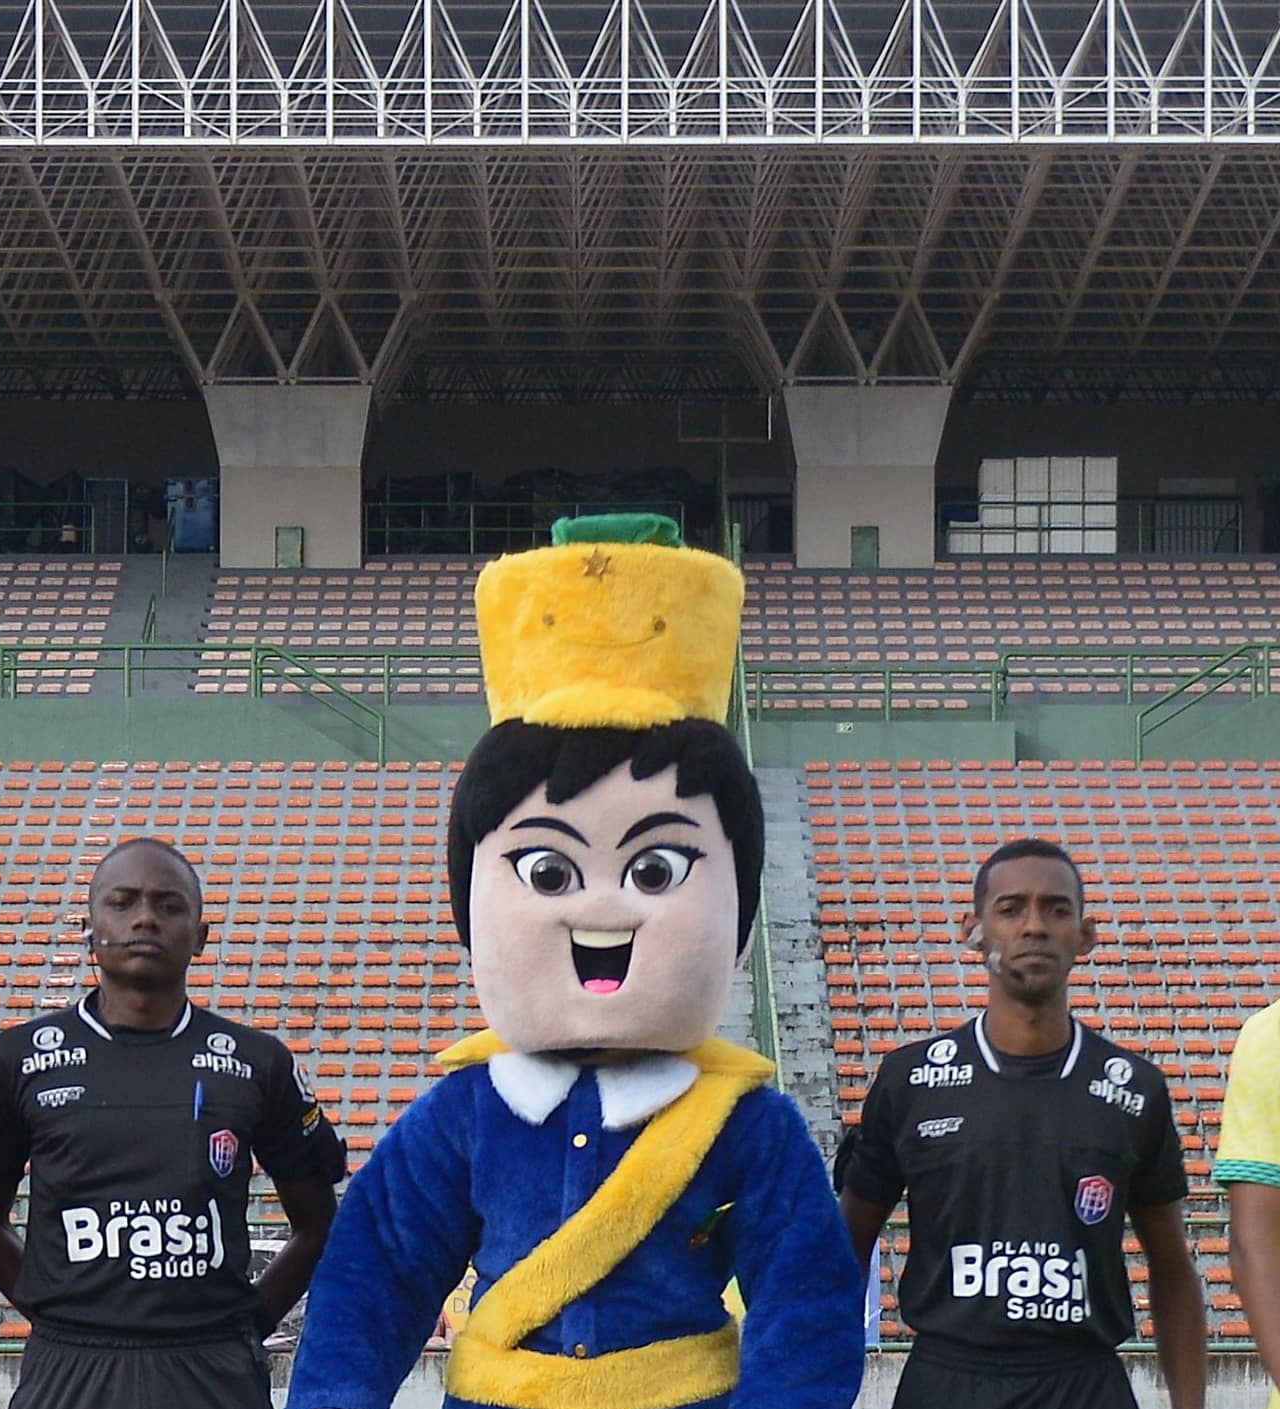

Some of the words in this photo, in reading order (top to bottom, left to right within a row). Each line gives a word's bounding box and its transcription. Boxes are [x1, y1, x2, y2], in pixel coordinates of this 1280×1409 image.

[22, 1047, 87, 1074] alpha
[191, 1052, 252, 1079] alpha
[908, 1063, 973, 1087] alpha
[1088, 1079, 1145, 1111] alpha
[110, 1198, 182, 1215] PLANO
[992, 1241, 1060, 1256] PLANO
[130, 1256, 207, 1280] Saúde
[1007, 1297, 1084, 1323] Saúde
